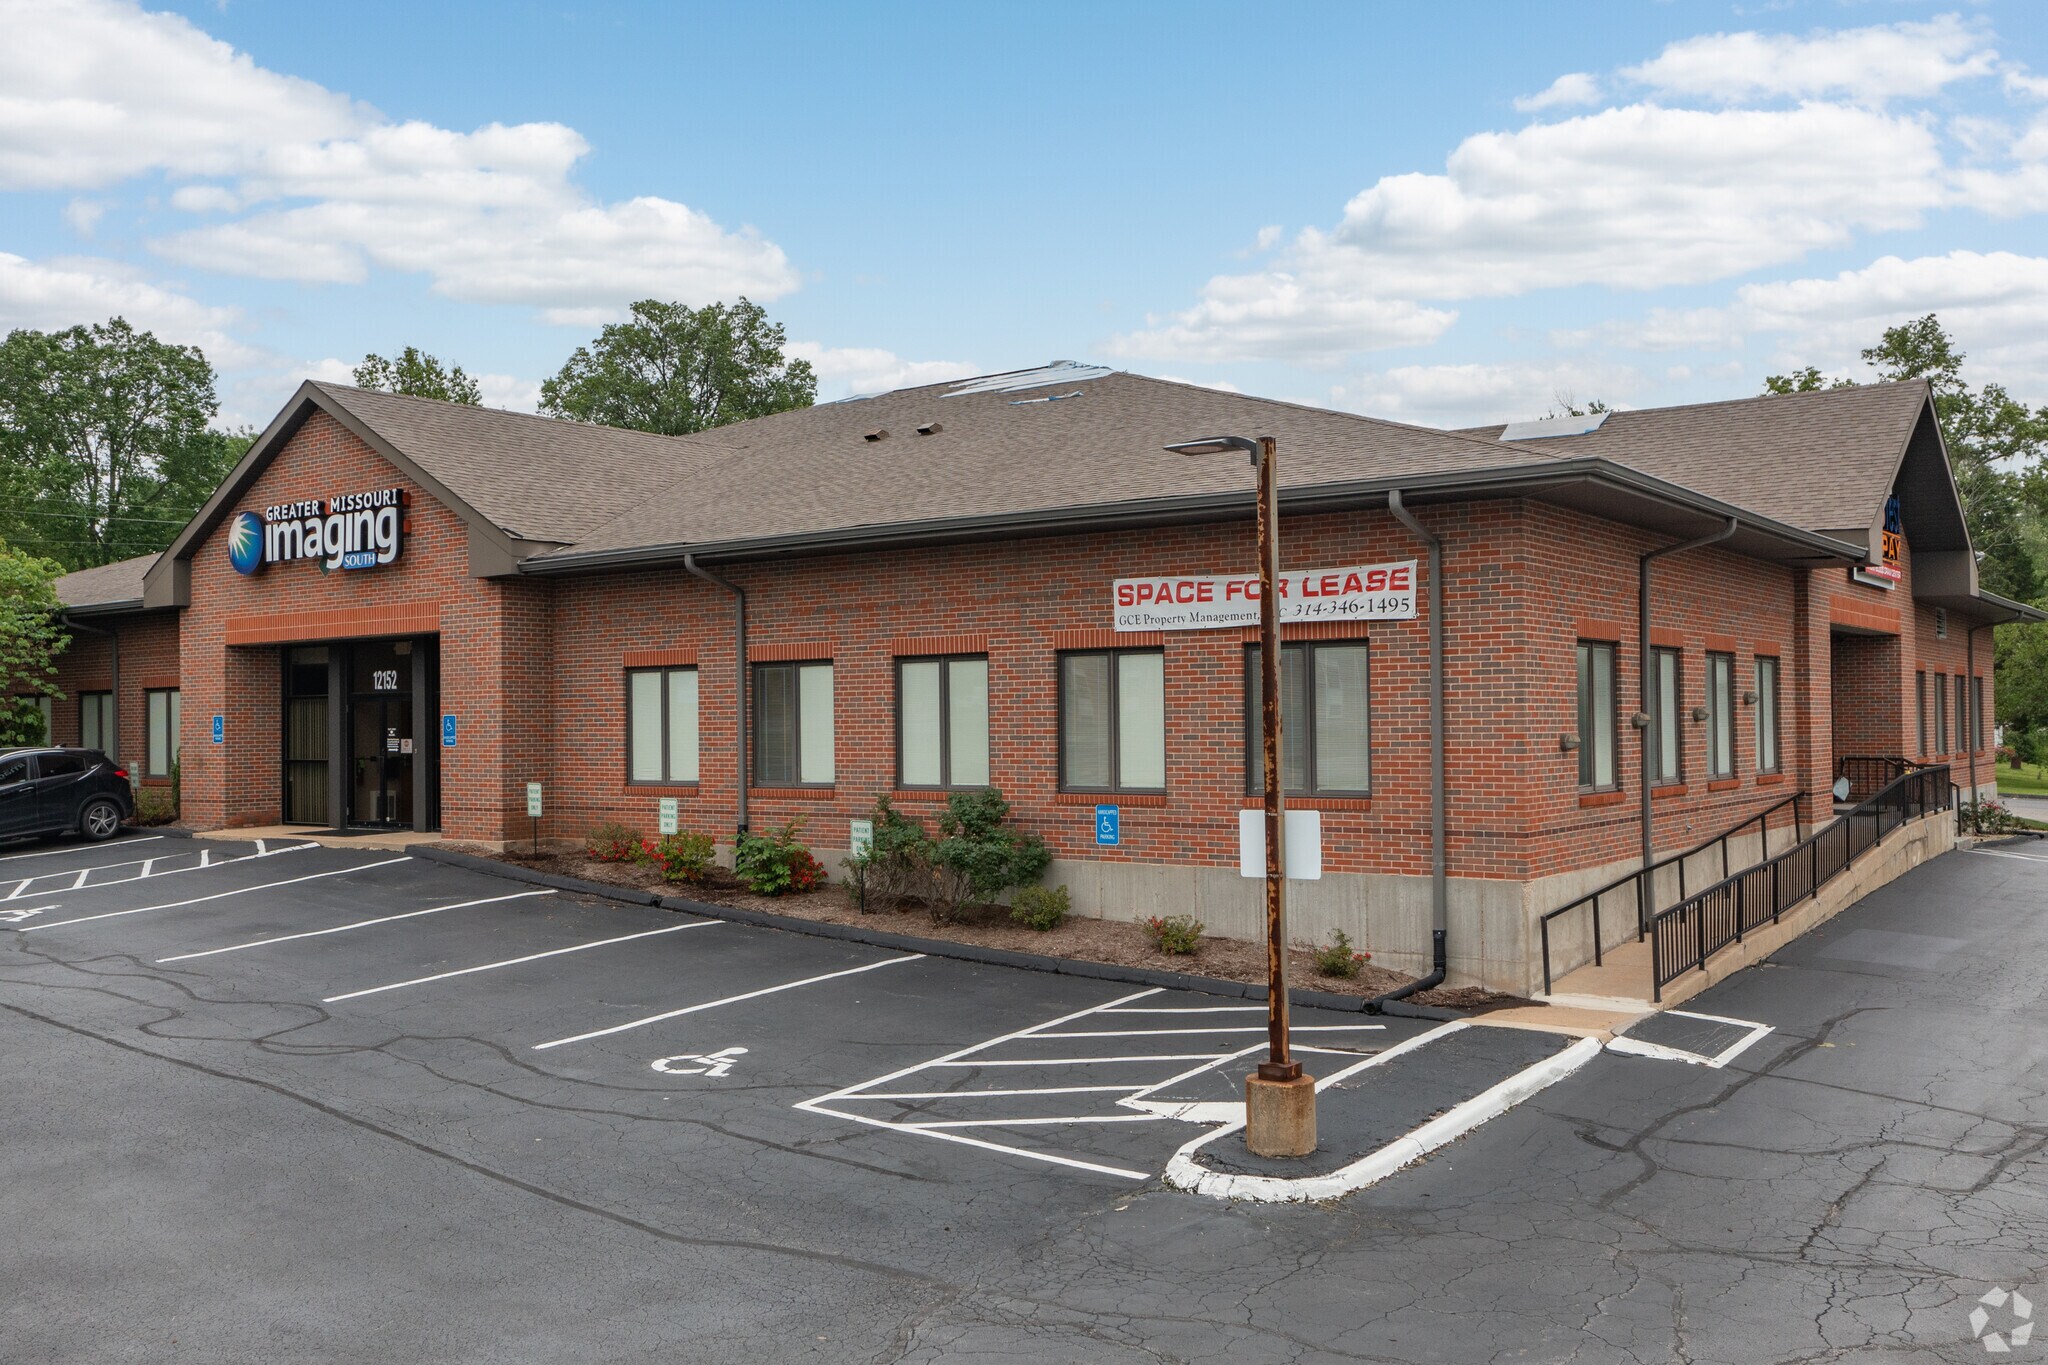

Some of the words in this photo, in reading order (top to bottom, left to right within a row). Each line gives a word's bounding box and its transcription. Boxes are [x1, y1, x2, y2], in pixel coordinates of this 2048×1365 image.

[266, 500, 319, 522] GREATER
[330, 488, 398, 514] MISSOURI
[344, 553, 376, 567] SOUTH
[1117, 581, 1215, 607] SPACE
[1301, 567, 1410, 598] LEASE
[1119, 614, 1141, 626] GCE
[1143, 613, 1187, 626] Property
[1292, 597, 1410, 618] 314-346-1495
[373, 670, 397, 690] 12152
[853, 826, 870, 834] PATIENT
